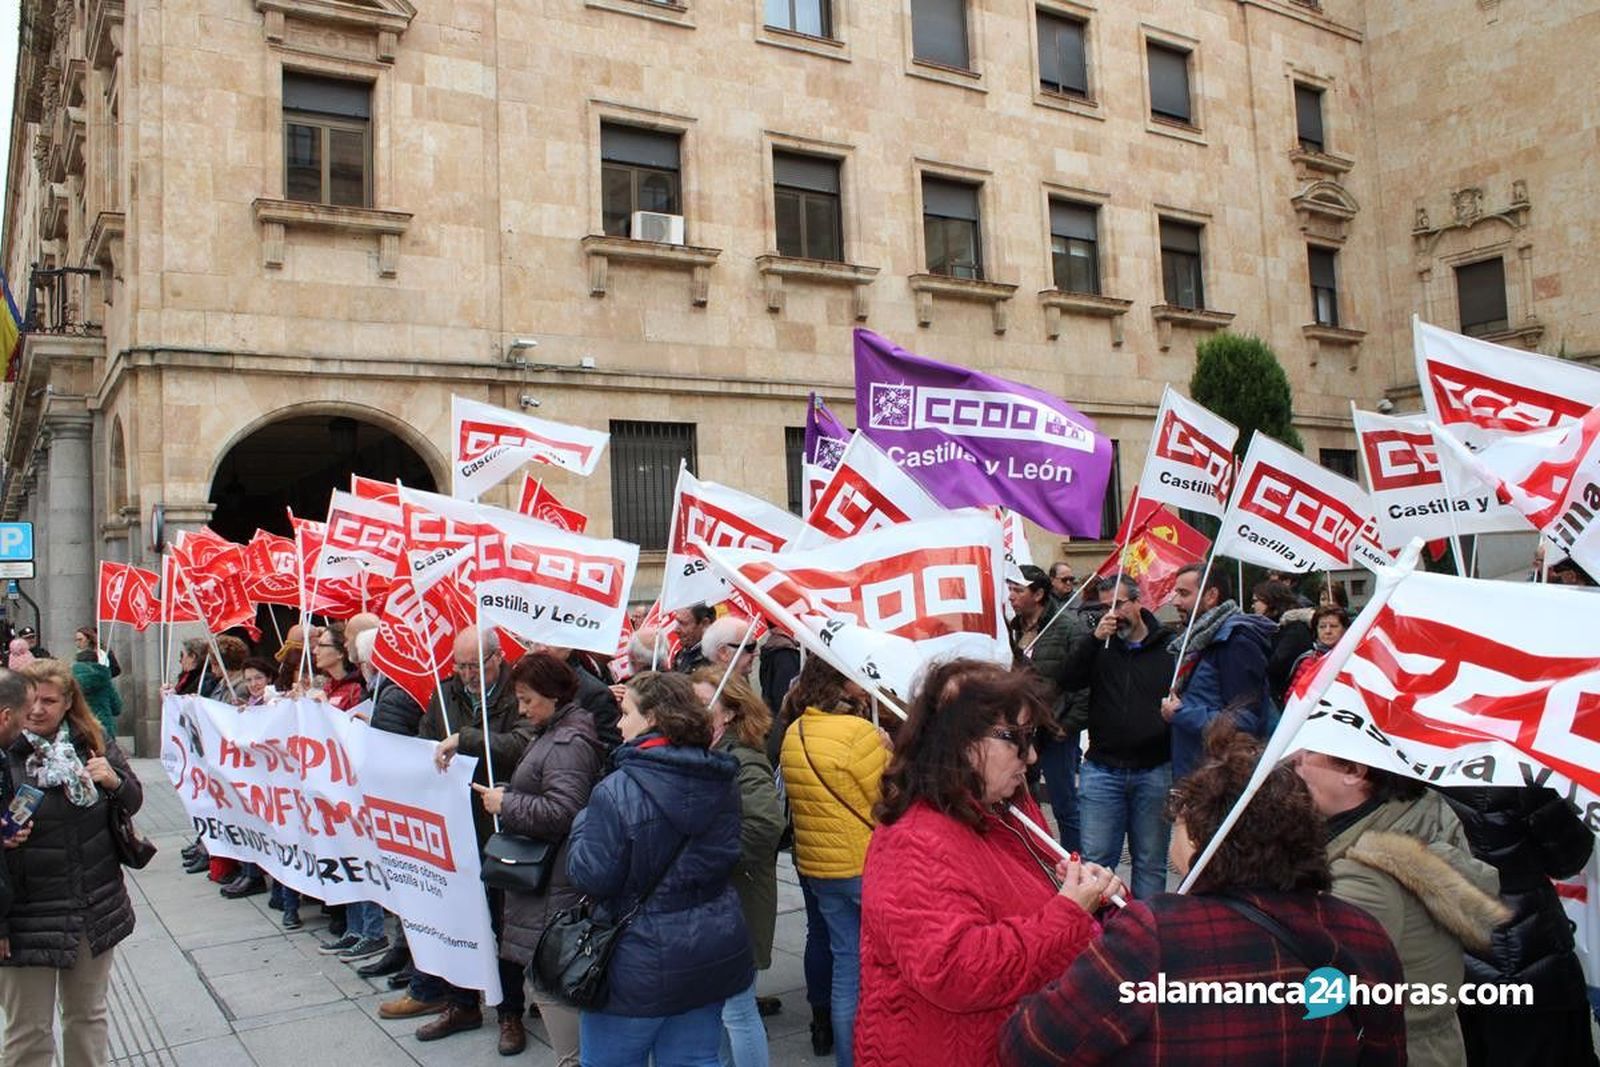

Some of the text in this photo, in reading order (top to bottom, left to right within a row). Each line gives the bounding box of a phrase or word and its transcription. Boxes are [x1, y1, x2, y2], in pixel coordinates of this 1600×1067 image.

[925, 397, 1039, 430] CCOO
[887, 442, 1072, 483] Castilla y León
[1251, 474, 1357, 550] CCOO
[1476, 496, 1490, 512] y
[1, 527, 24, 556] P
[1237, 523, 1296, 561] Castilla
[480, 534, 618, 595] CCOO
[384, 582, 454, 652] UGT
[482, 592, 601, 630] astilla y León
[371, 807, 446, 861] CCOO
